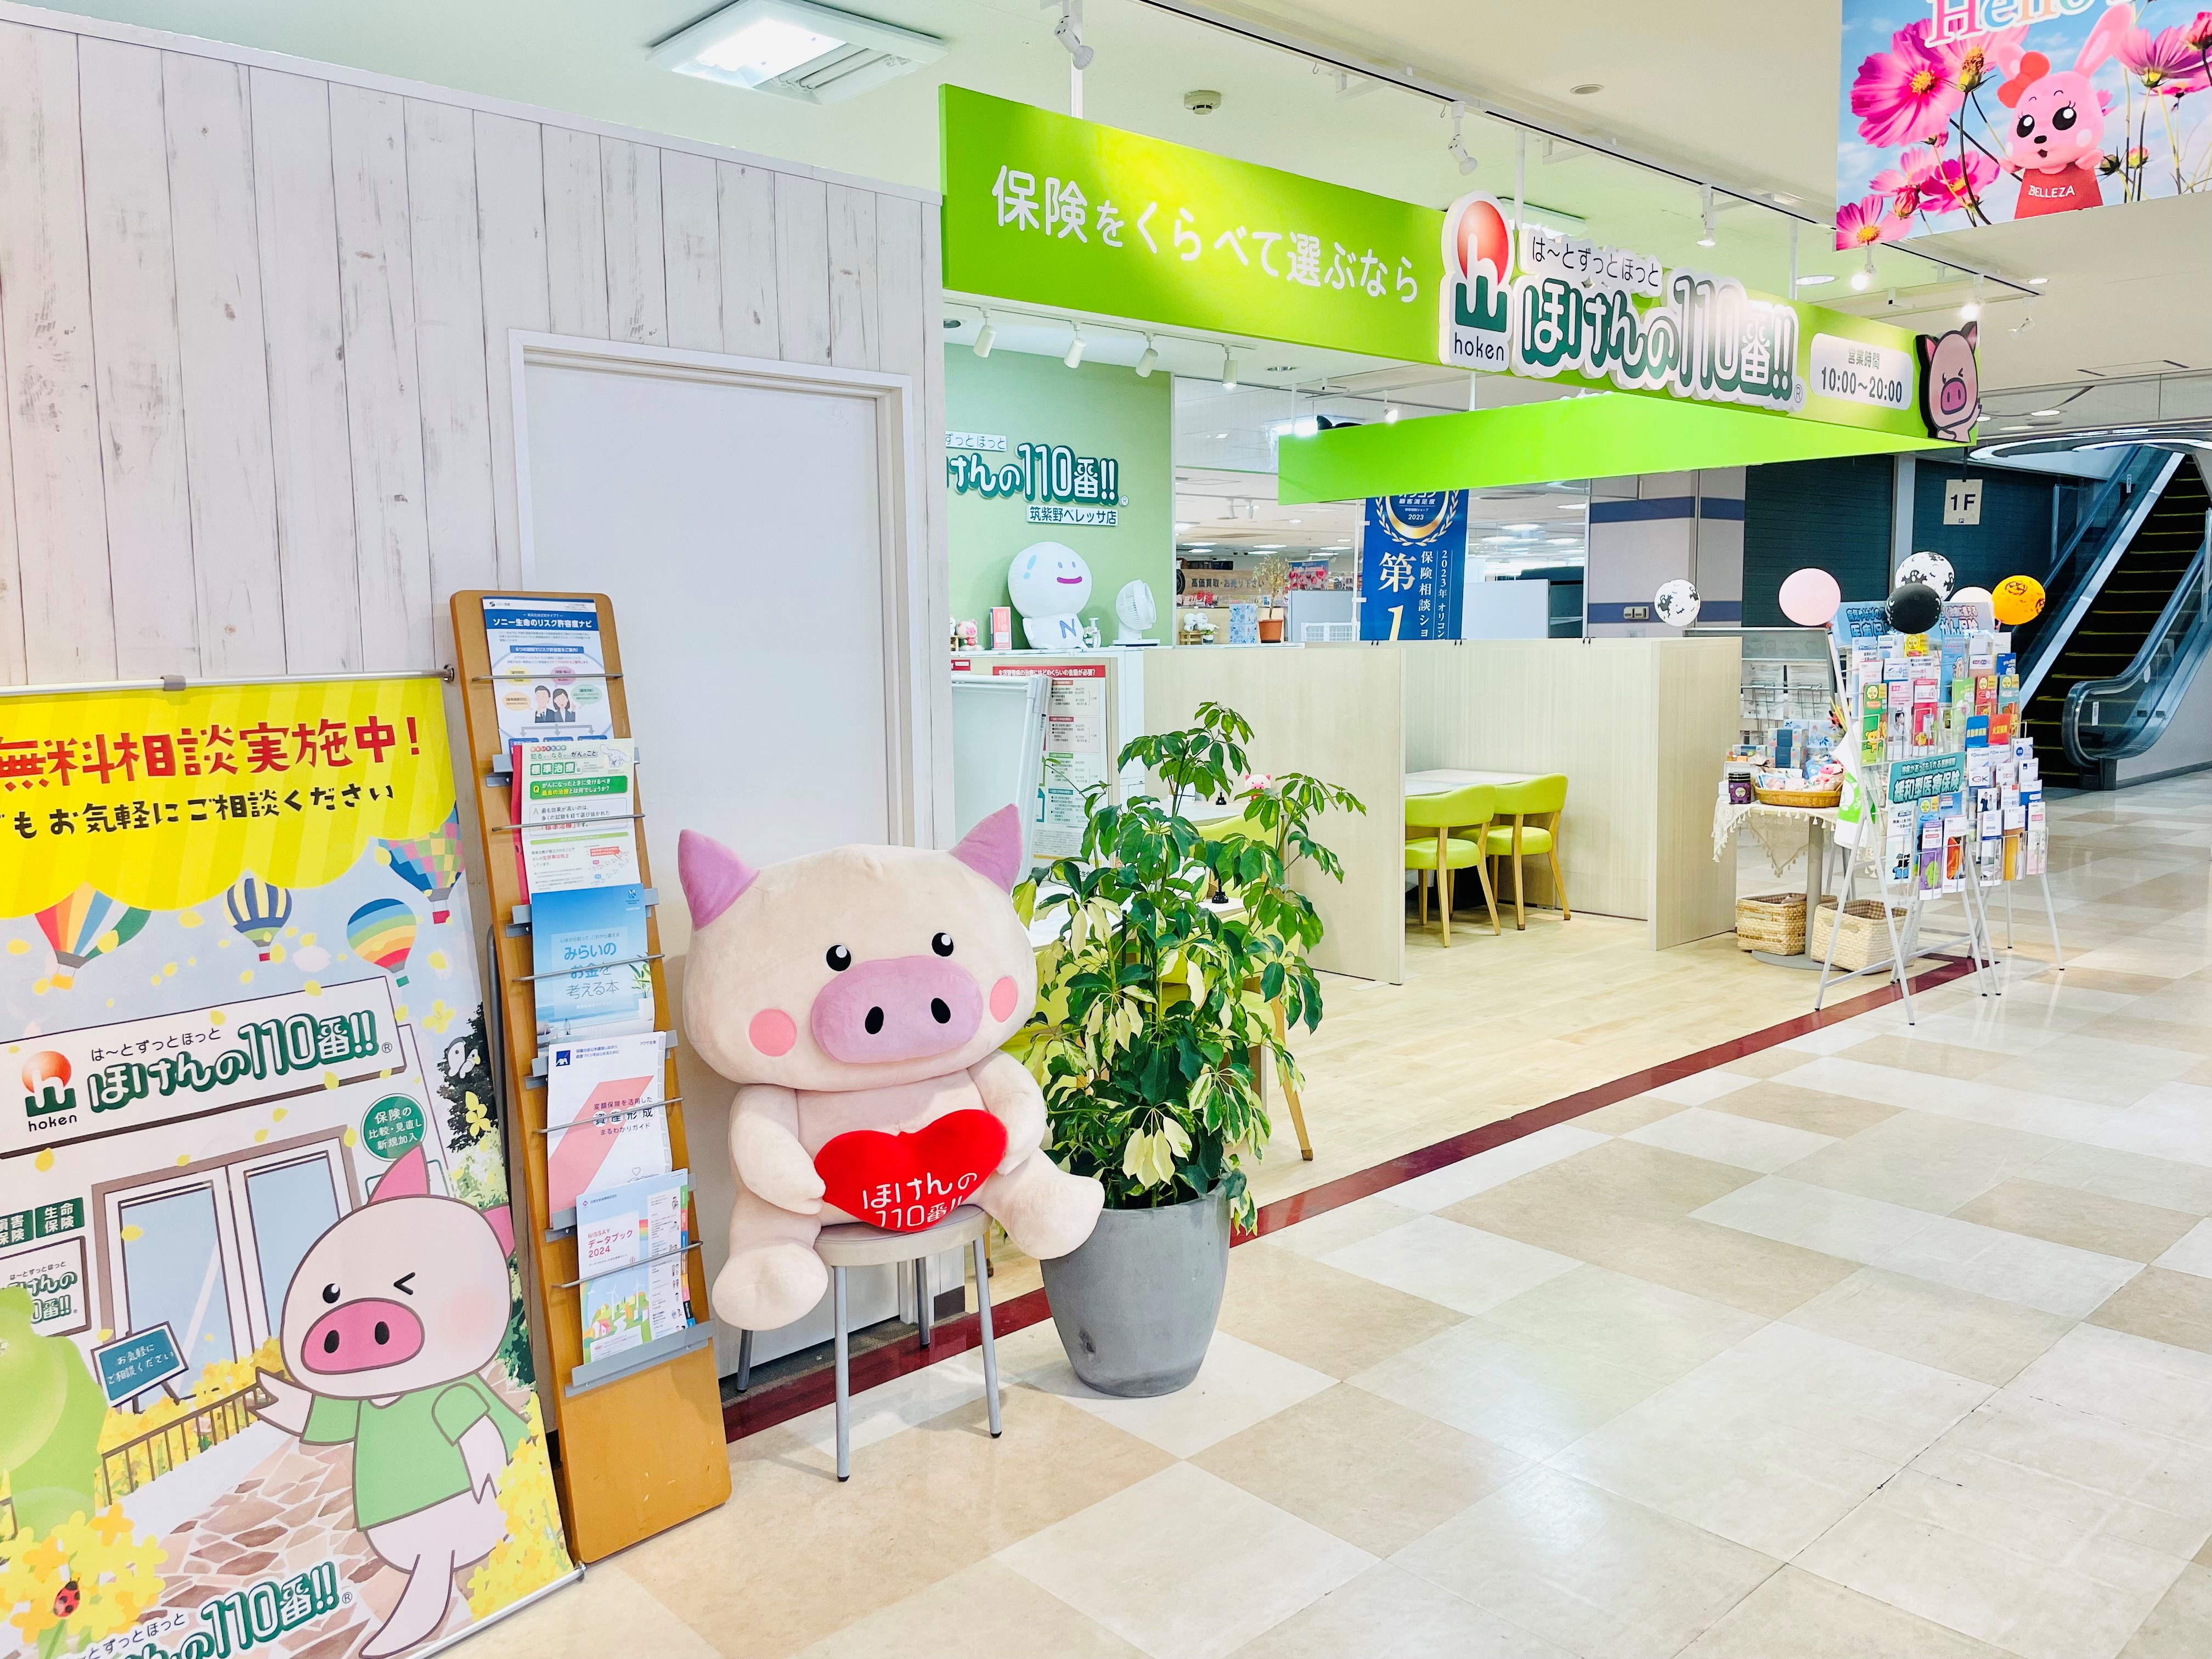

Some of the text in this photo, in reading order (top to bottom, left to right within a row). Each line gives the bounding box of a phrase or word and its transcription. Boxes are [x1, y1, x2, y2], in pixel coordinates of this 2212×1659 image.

[2028, 184, 2076, 199] BELLEZA
[991, 165, 1419, 303] 保険をくらべて選ぶなら
[1454, 337, 1504, 362] hoken
[1848, 347, 1880, 370] 営業時間
[1950, 494, 1976, 511] 1F
[1030, 505, 1117, 525] 筑紫野ベレッサ店
[1418, 550, 1434, 637] 保険相談ショ
[1437, 550, 1448, 640] 2023年 オリコン
[493, 618, 592, 629] ソニー生命のリスク許容度ナビ
[533, 785, 540, 794] Q
[0, 783, 394, 839] もお気軽にご相談ください
[564, 942, 617, 961] みらいの
[566, 979, 620, 1000] 考える本
[594, 1097, 653, 1110] 変額保険を活用した
[29, 1113, 78, 1132] hoken
[375, 1107, 412, 1125] 保険の
[368, 1118, 422, 1140] 比較・見直し
[601, 1123, 651, 1136] まるわかりガイド
[377, 1132, 418, 1150] 新規加入
[862, 1171, 978, 1210] ほけんの
[44, 1202, 74, 1220] 生命
[44, 1215, 75, 1234] 保険
[588, 1228, 611, 1239] NISSAY
[588, 1229, 633, 1249] データブック
[589, 1245, 611, 1259] 2024
[117, 1344, 155, 1366] お気軽に
[107, 1351, 174, 1385] ご相談ください
